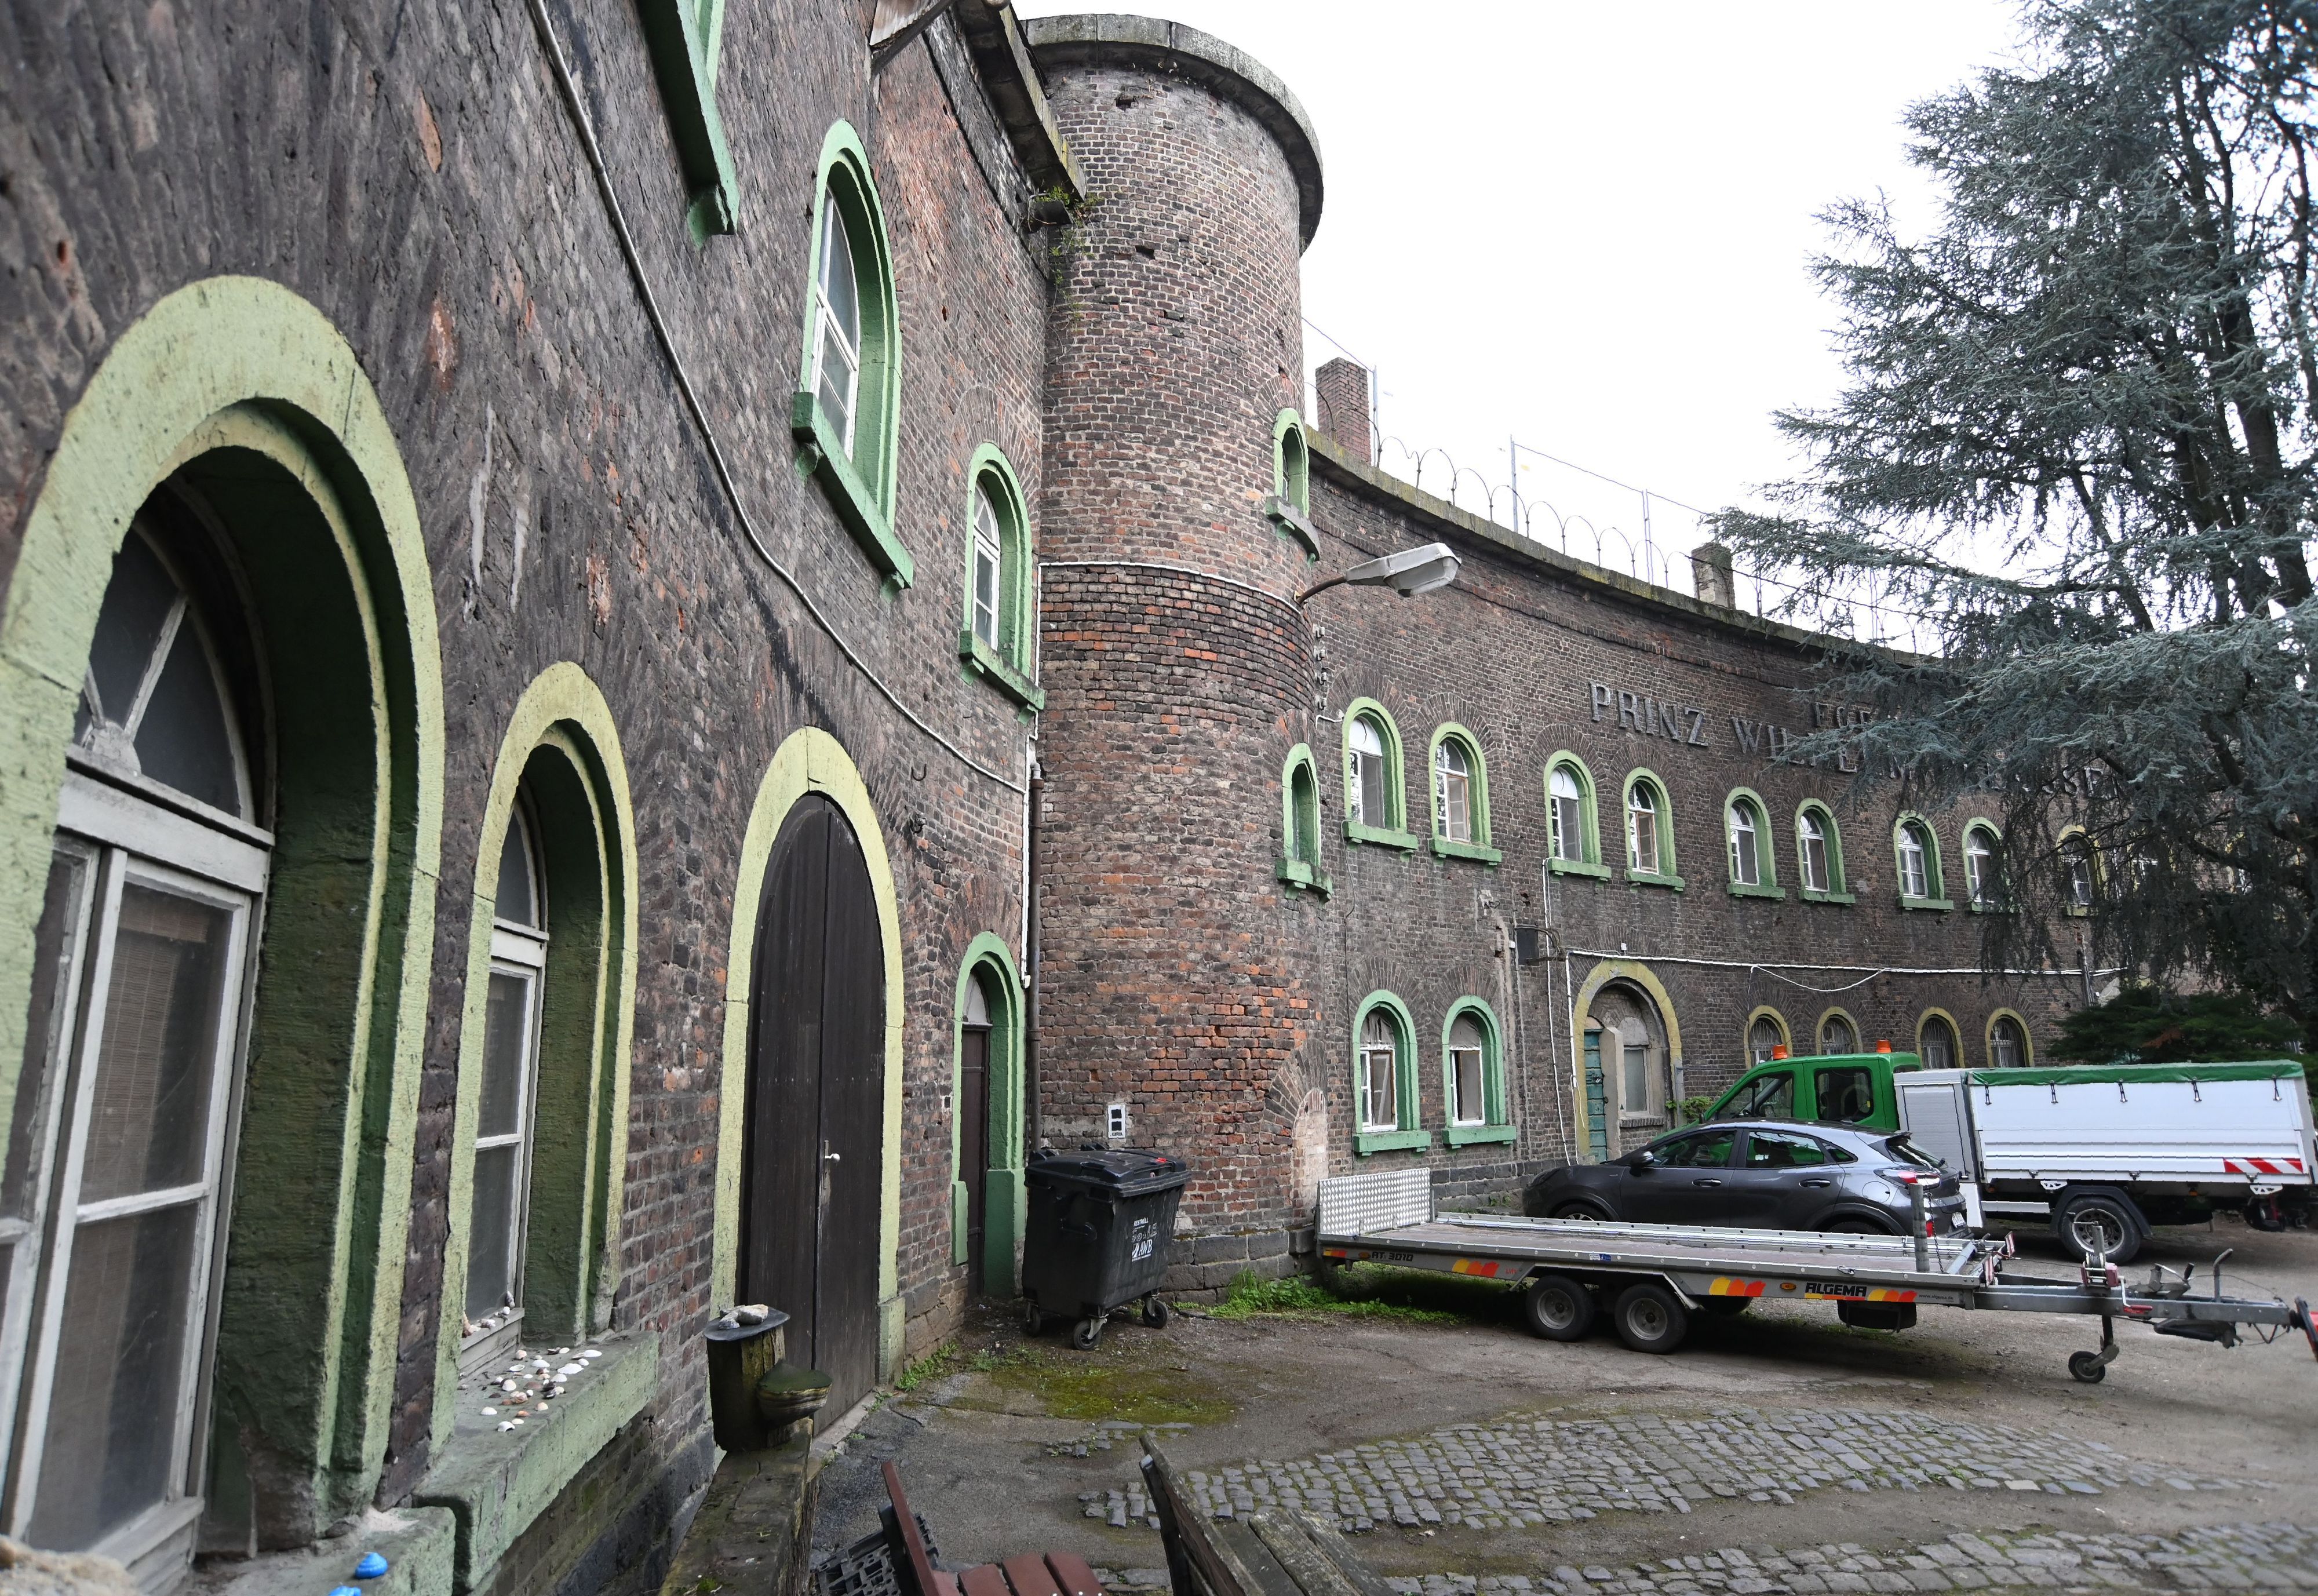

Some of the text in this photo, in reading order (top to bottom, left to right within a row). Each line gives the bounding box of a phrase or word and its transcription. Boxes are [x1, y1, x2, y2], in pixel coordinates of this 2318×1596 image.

[1590, 680, 1709, 746] PRINZ
[1138, 1239, 1153, 1256] AWB
[1388, 1252, 1414, 1262] 3010
[1805, 1282, 1867, 1297] ALGEMA
